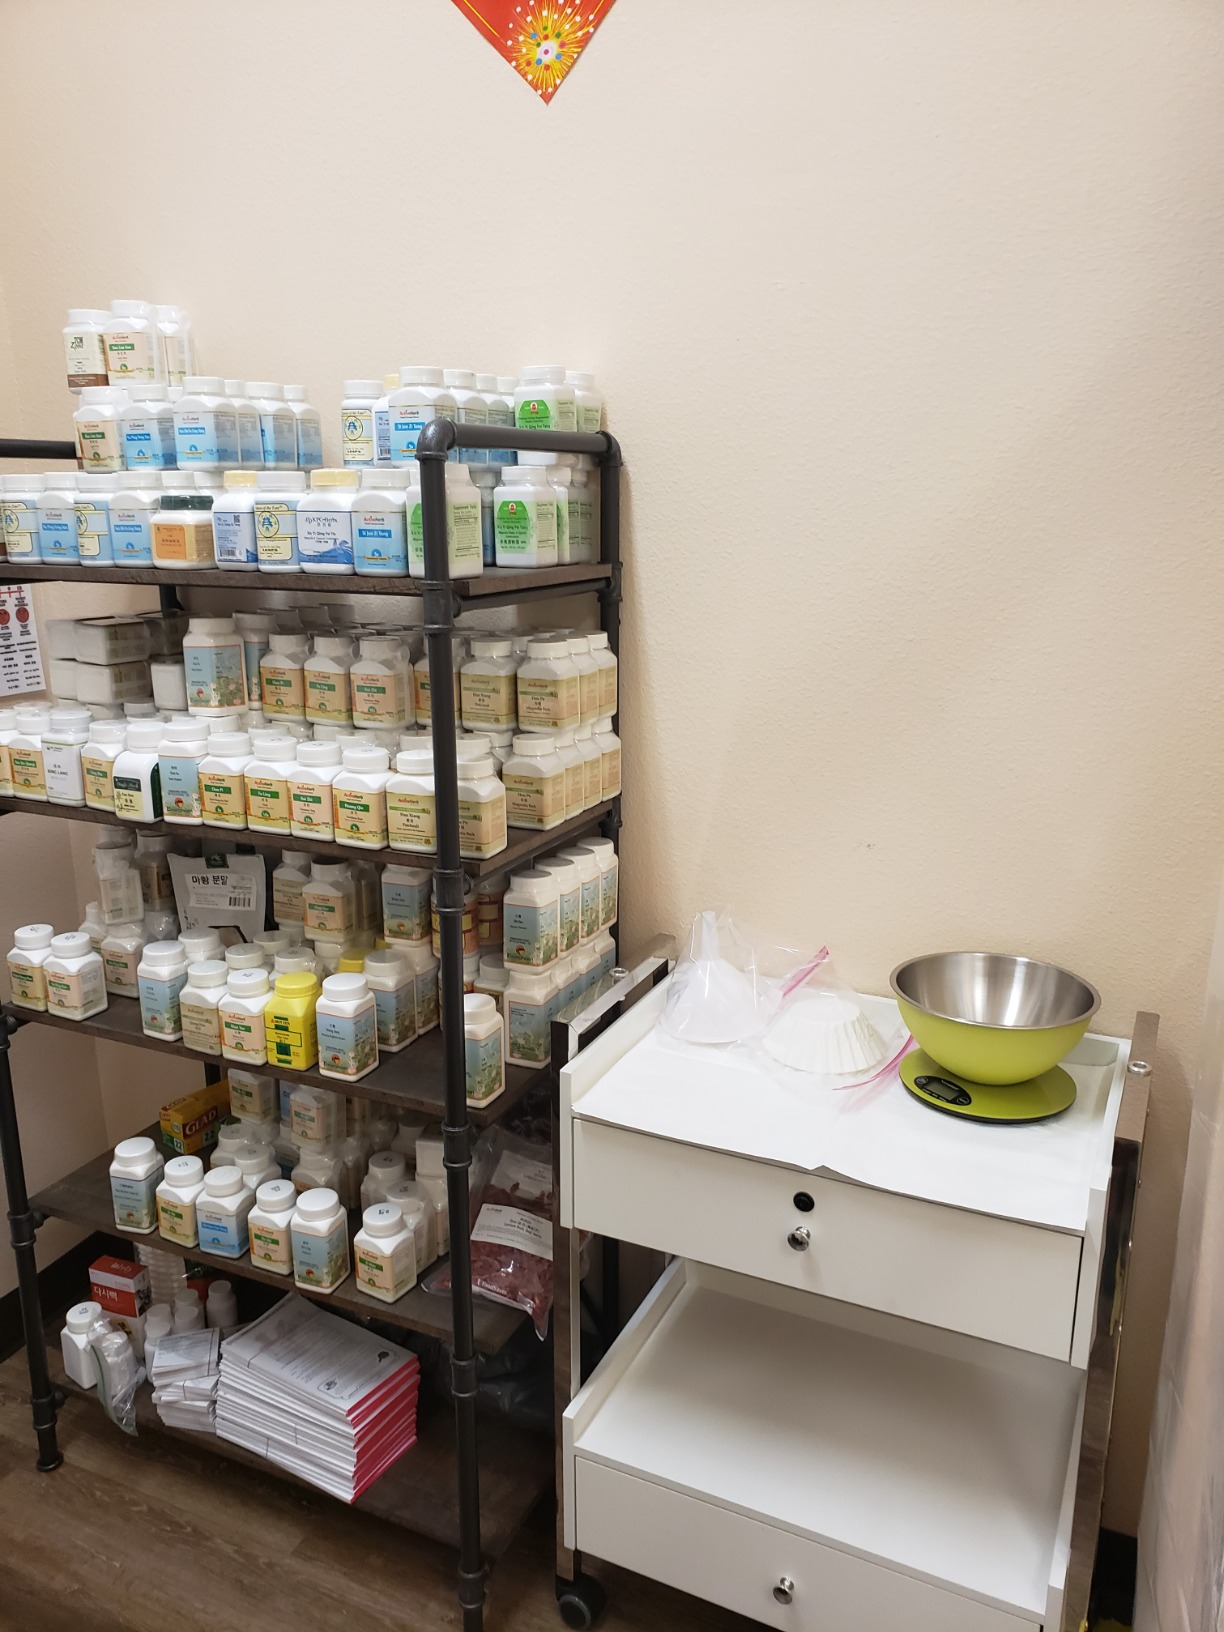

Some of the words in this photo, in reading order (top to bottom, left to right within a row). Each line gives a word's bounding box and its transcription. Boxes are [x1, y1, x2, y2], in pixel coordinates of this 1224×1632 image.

[192, 875, 210, 885] 마황
[212, 875, 228, 886] 분말
[185, 1110, 216, 1135] GLAD
[204, 1130, 214, 1142] 22
[174, 1140, 182, 1150] 22
